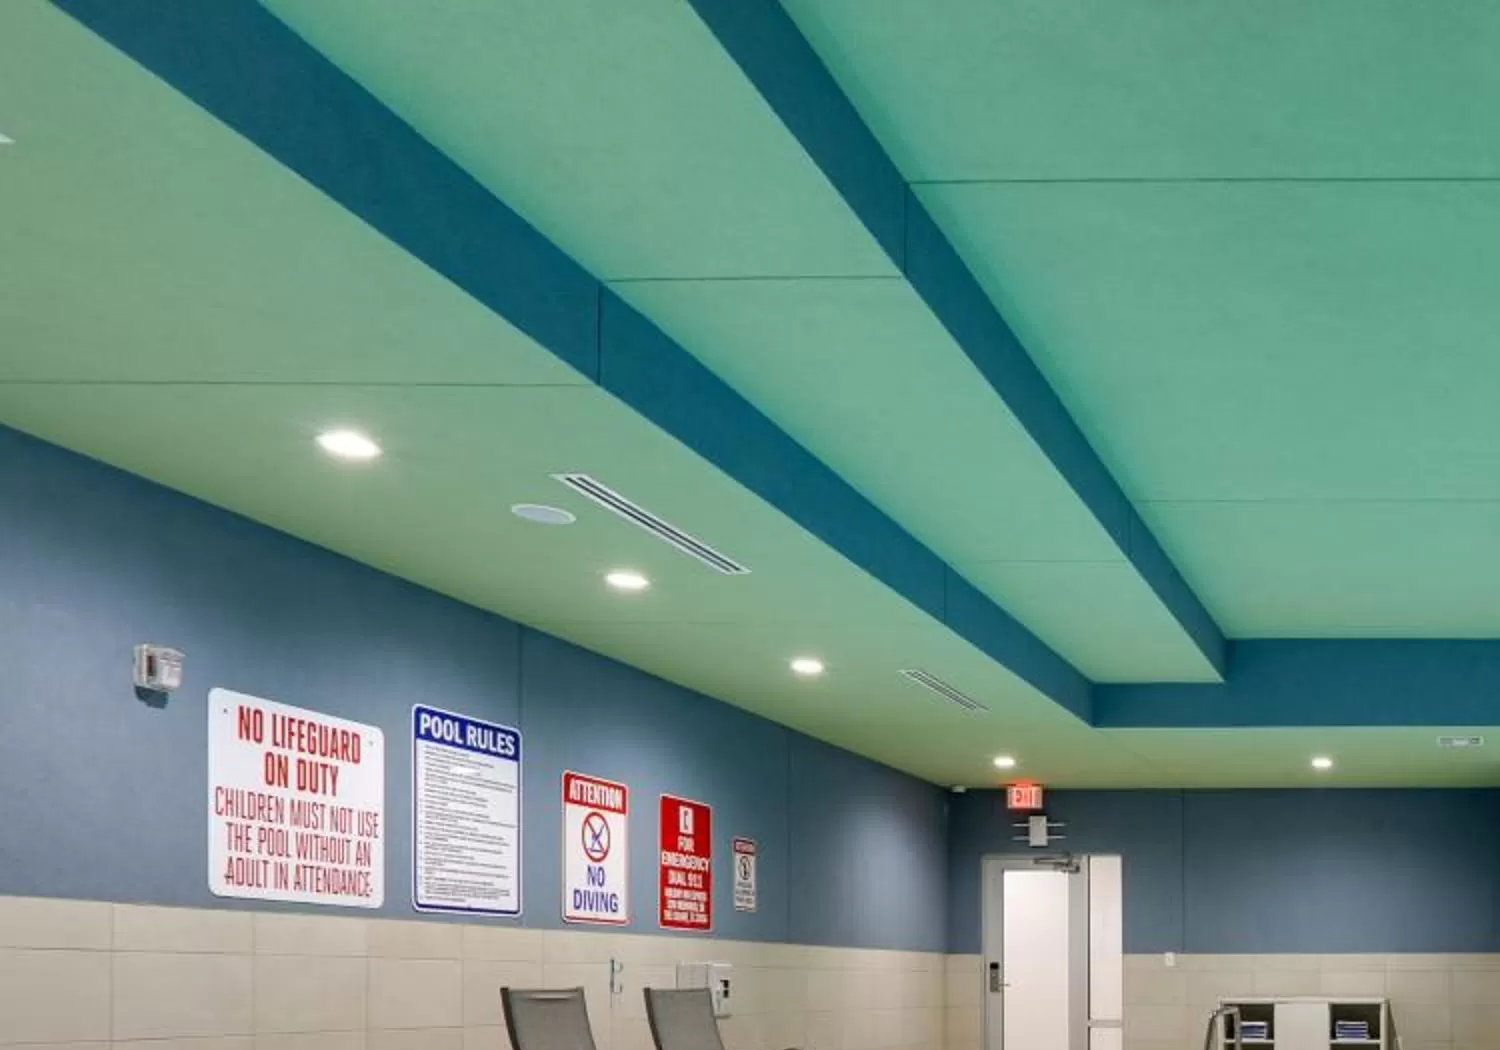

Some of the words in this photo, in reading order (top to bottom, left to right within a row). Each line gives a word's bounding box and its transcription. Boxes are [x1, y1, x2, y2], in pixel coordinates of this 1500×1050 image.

[238, 705, 263, 743] NO
[272, 713, 361, 764] LIFEGUARD
[420, 713, 463, 745] POOL
[467, 725, 515, 756] RULES
[265, 752, 289, 788] ON
[297, 758, 339, 797] DUTY
[569, 778, 623, 810] ATTENTION
[215, 786, 284, 824] CHILDREN
[290, 799, 325, 830] MUST
[330, 806, 353, 834] NOT
[358, 811, 379, 838] USE
[226, 822, 252, 853] THE
[259, 827, 291, 858] POOL
[296, 832, 351, 865] WITHOUT
[356, 841, 371, 868] AN
[226, 856, 269, 888] ADULT
[274, 862, 289, 890] IN
[587, 865, 605, 887] NO
[573, 889, 619, 913] DIVING
